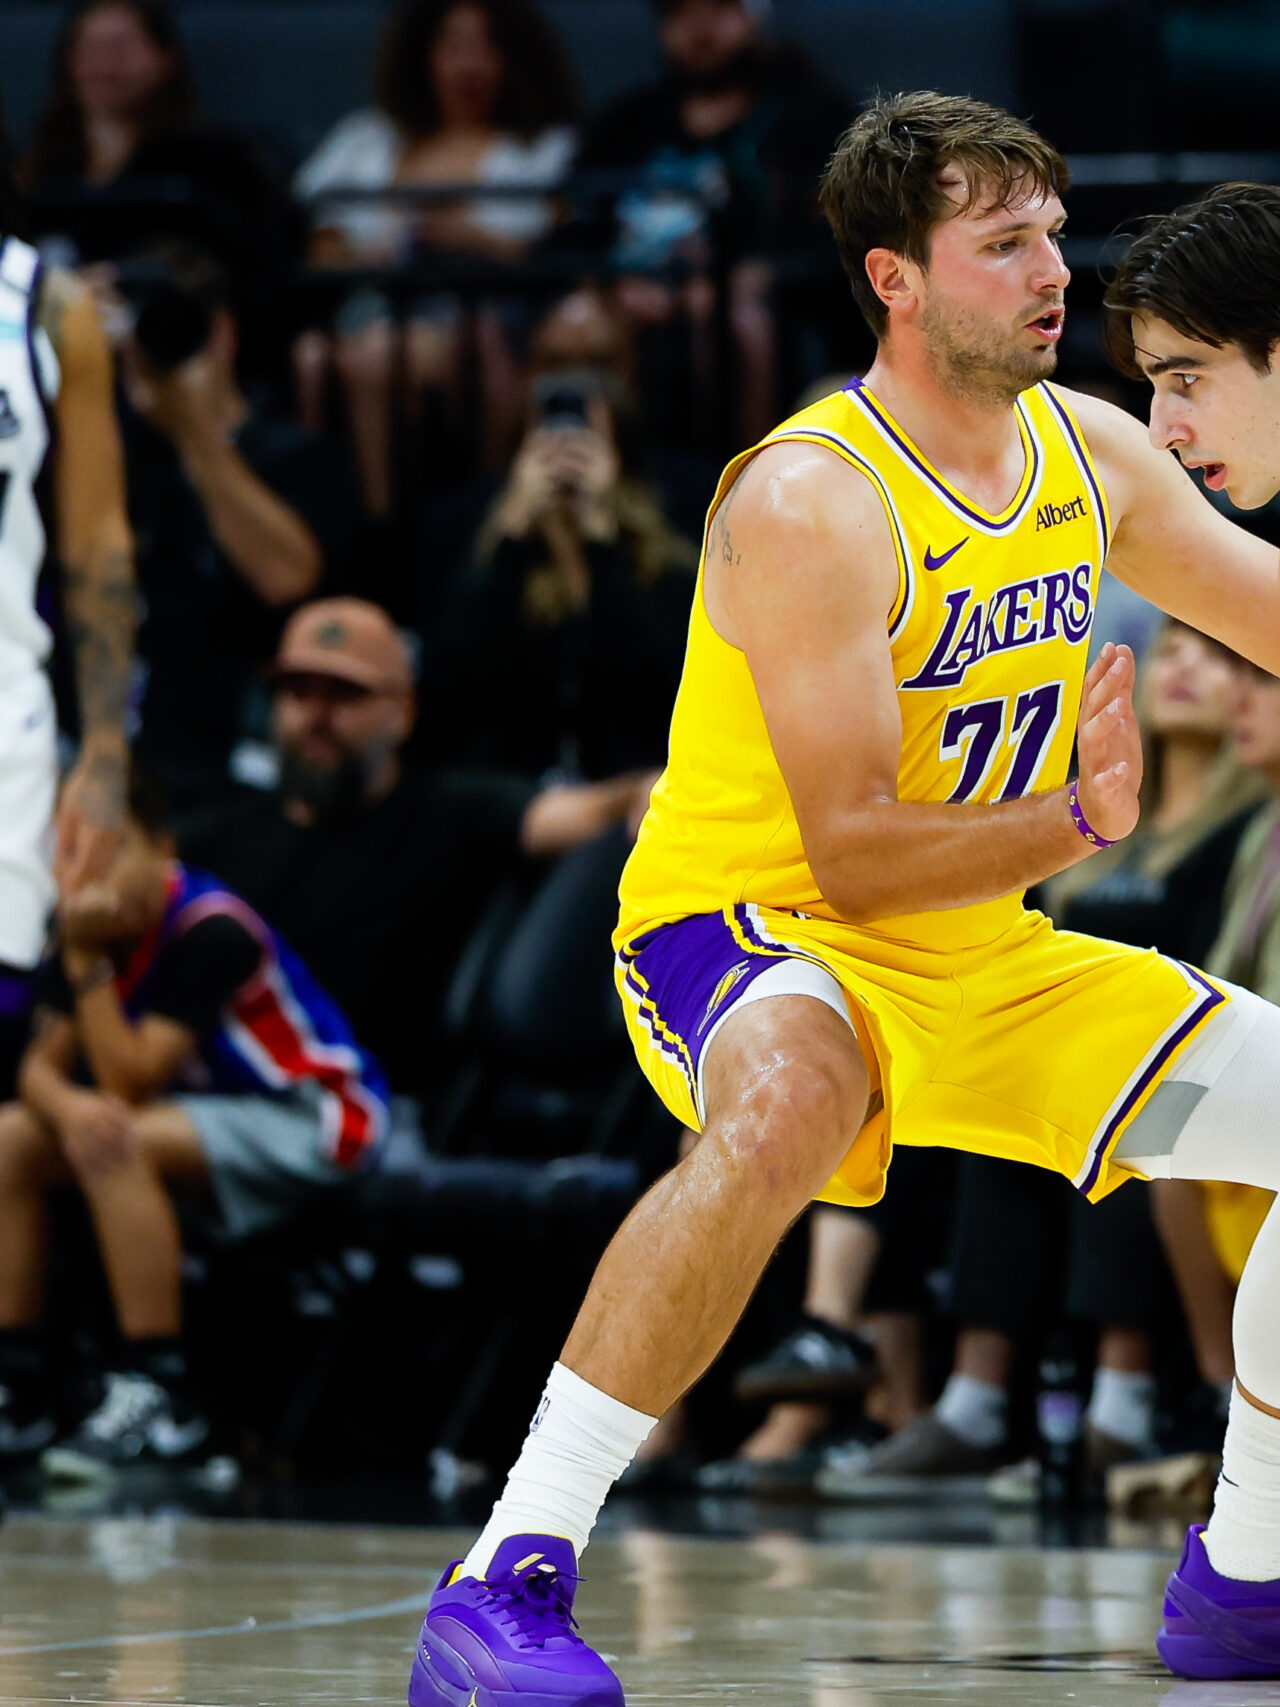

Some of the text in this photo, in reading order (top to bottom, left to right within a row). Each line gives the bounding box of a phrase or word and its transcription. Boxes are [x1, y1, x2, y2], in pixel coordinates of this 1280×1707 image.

[1036, 496, 1087, 532] Albert
[898, 561, 1094, 690] LAKERS
[939, 680, 1065, 804] 77
